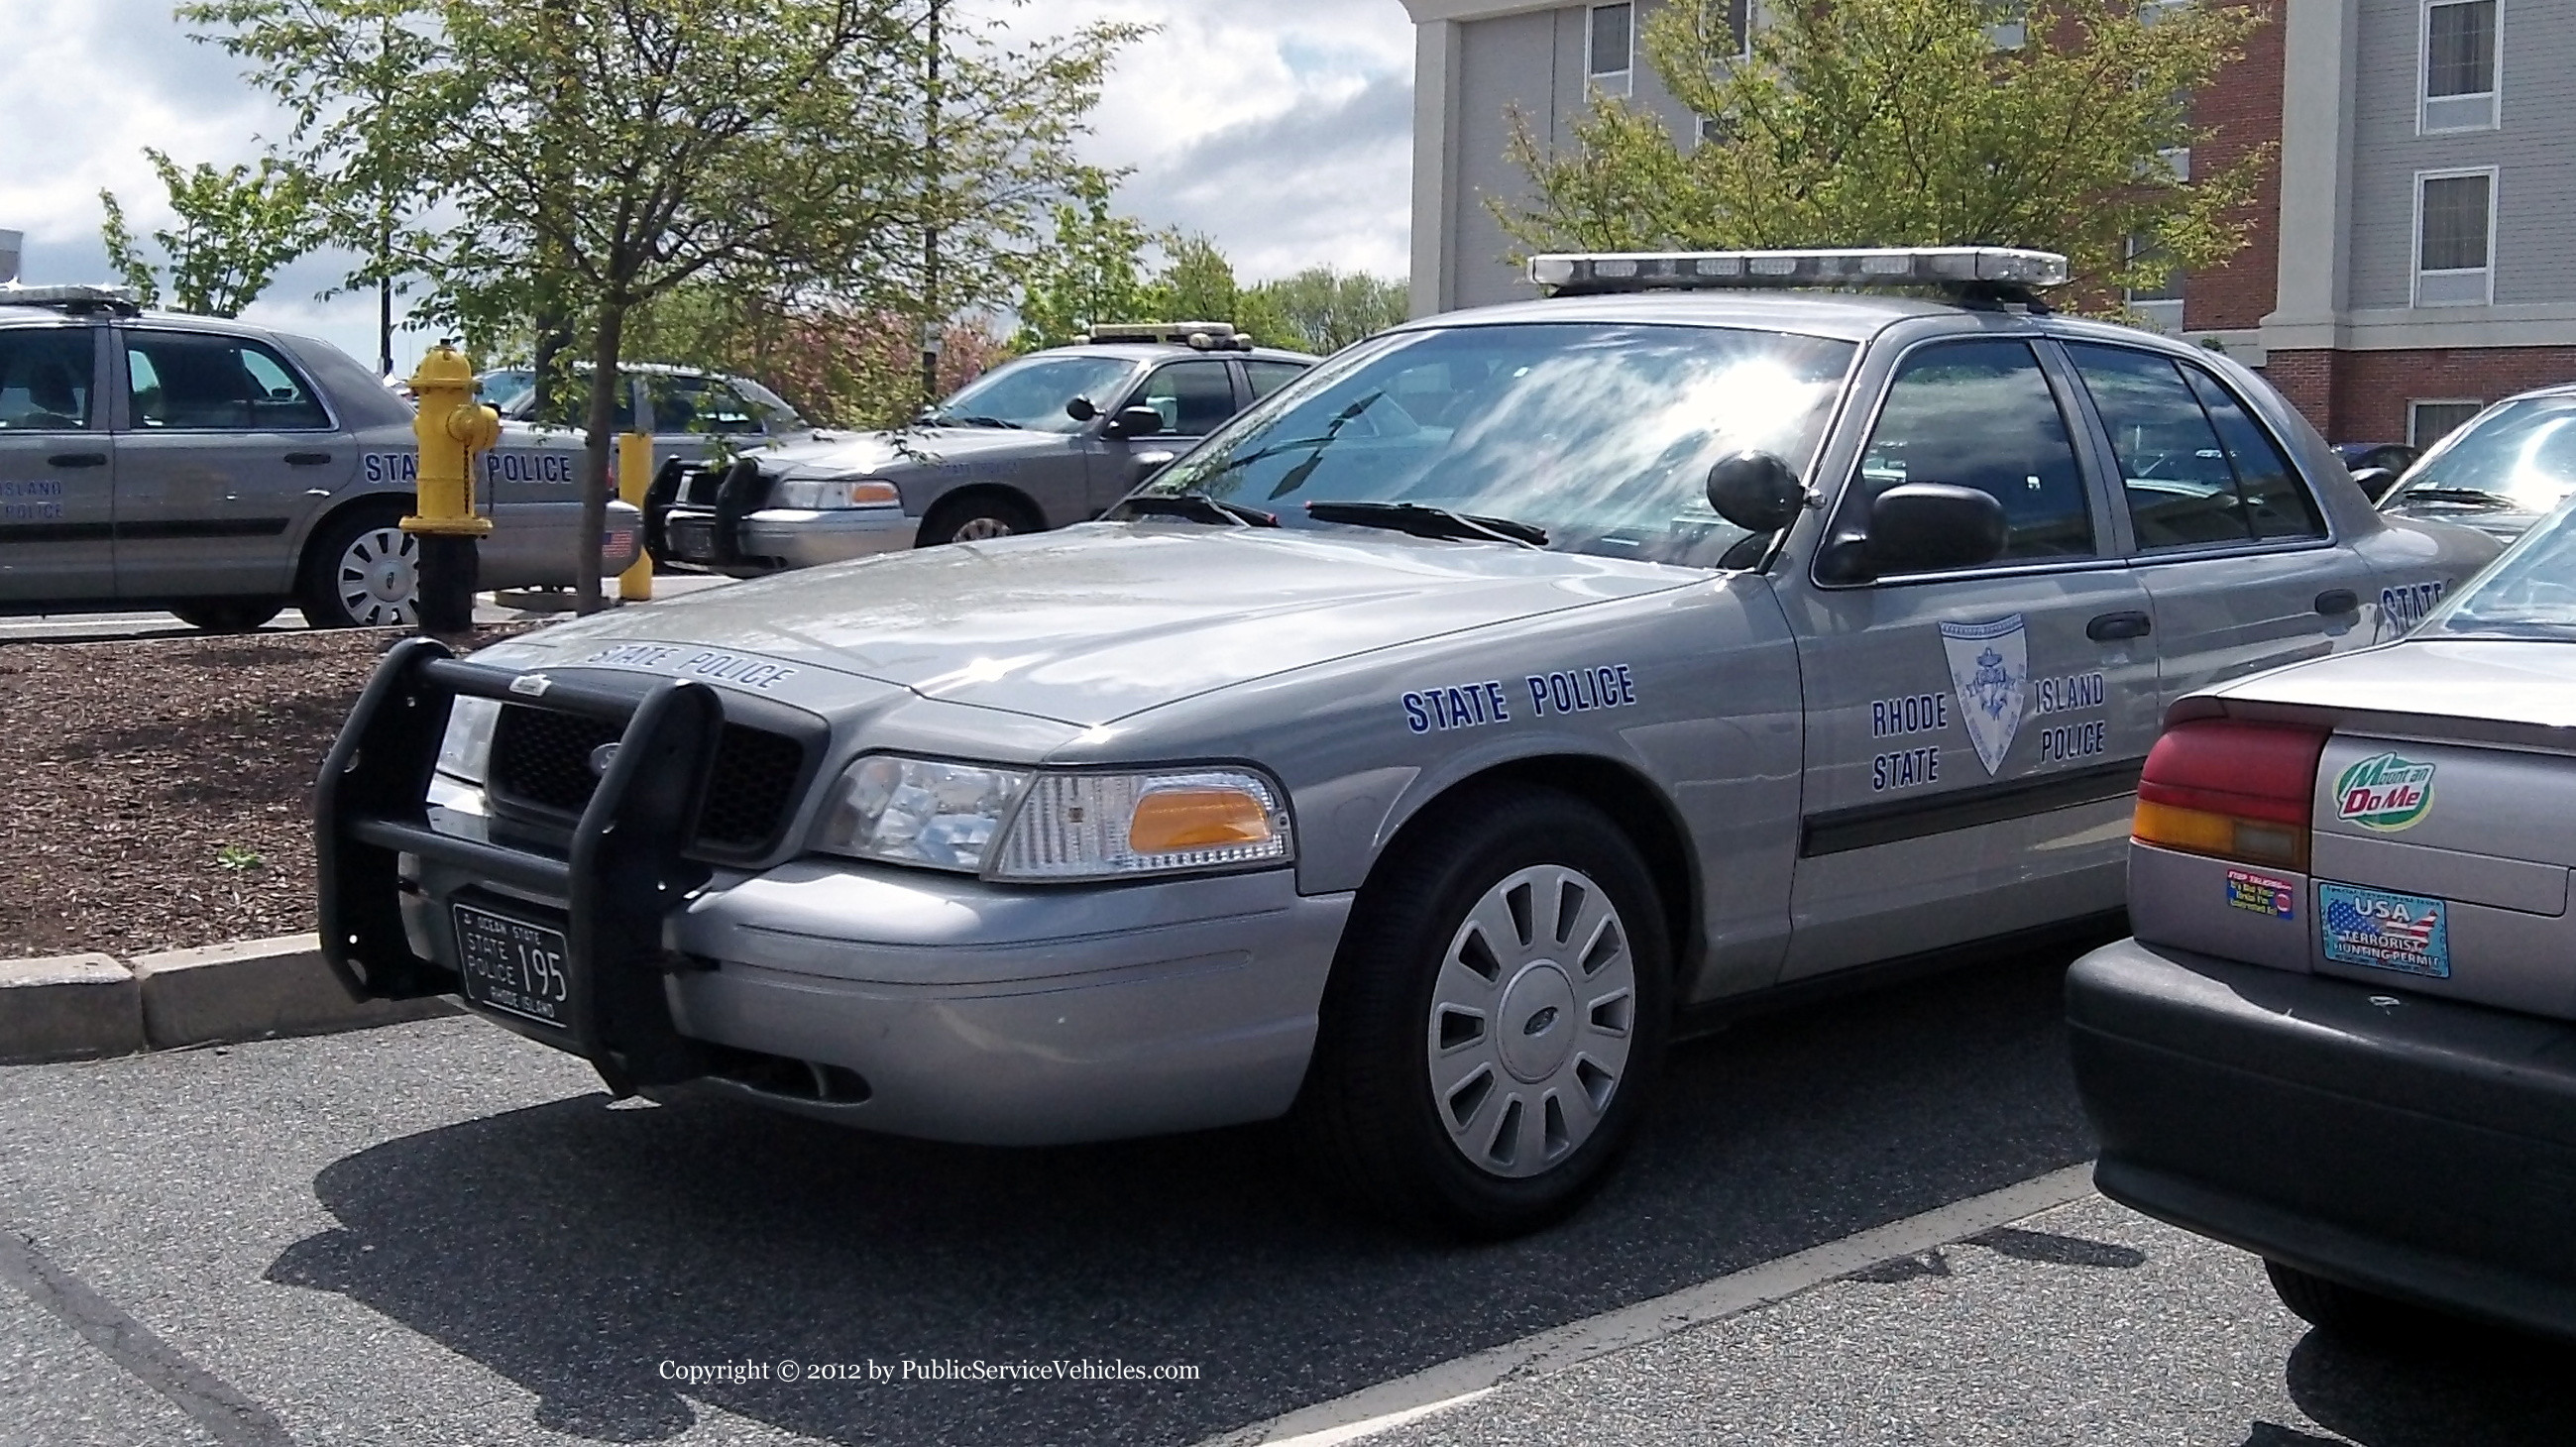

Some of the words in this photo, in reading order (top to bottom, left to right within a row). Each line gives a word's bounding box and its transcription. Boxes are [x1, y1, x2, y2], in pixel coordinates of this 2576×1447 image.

[365, 452, 419, 483] STA
[486, 452, 573, 484] POLICE
[587, 643, 681, 667] STATE
[674, 650, 799, 691] POLICE
[1401, 680, 1511, 734] STATE
[1525, 663, 1636, 718] POLICE
[1870, 691, 1949, 739] RHODE
[2034, 671, 2106, 715] ISLAND
[1871, 746, 1941, 793] STATE
[2039, 720, 2106, 764] POLICE
[2340, 752, 2410, 800] Mount
[2410, 767, 2429, 783] an
[2343, 789, 2382, 815] Do
[2382, 785, 2420, 809] Me
[2354, 896, 2411, 923] USA
[477, 916, 507, 936] OCEAN
[512, 926, 542, 946] STATE
[2344, 930, 2422, 953] TERRORIST
[466, 933, 509, 961] STATE
[517, 944, 568, 1003] 195
[467, 954, 516, 986] POLICE
[2332, 943, 2392, 961] HUNTING
[2392, 951, 2440, 968] PERMIT
[490, 985, 519, 1009] RHODE
[521, 995, 556, 1019] ISLAND
